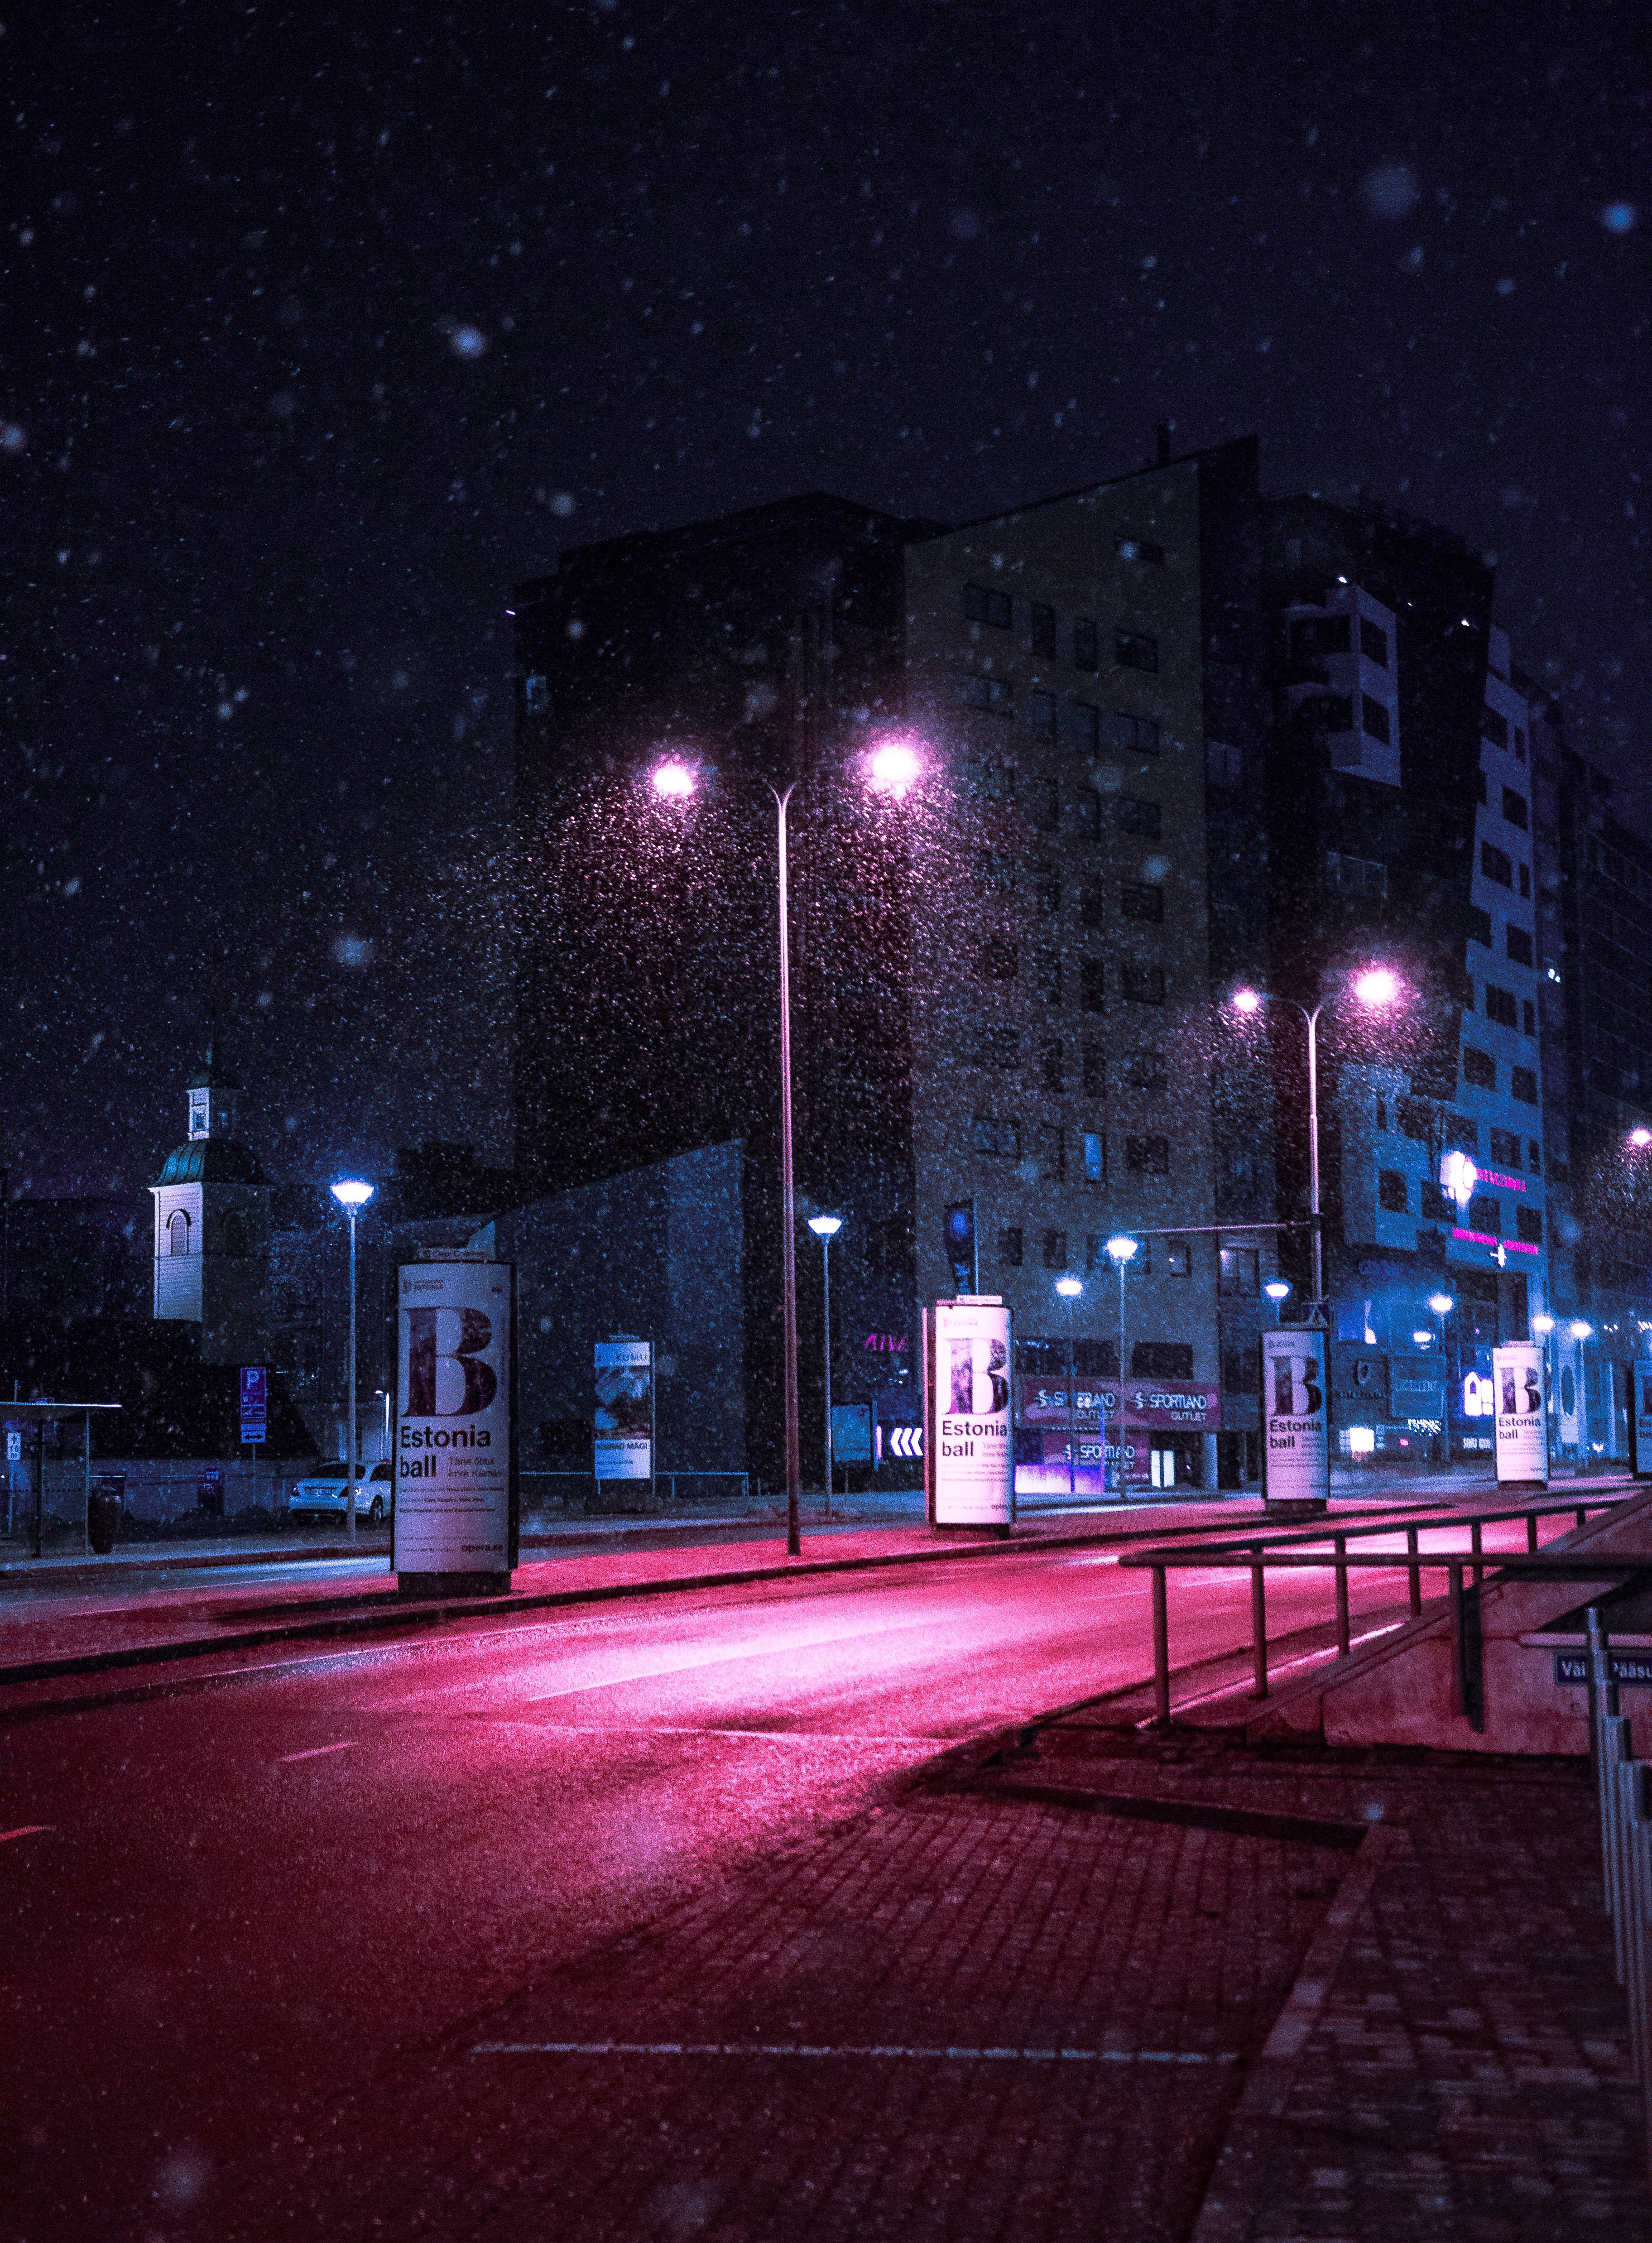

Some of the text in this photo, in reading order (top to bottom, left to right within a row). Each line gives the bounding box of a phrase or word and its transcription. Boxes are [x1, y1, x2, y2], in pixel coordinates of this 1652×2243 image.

[247, 1371, 259, 1389] P
[1150, 1394, 1207, 1409] SPORTLAND
[1171, 1411, 1207, 1422] OUTLET
[1499, 1416, 1541, 1427] Estonia
[942, 1419, 1008, 1436] Estonia
[1270, 1419, 1322, 1432] Estonia
[400, 1425, 491, 1448] Estonia
[1270, 1436, 1295, 1448] ball
[1499, 1429, 1518, 1440] ball
[942, 1441, 974, 1457] ball
[400, 1455, 436, 1478] ball
